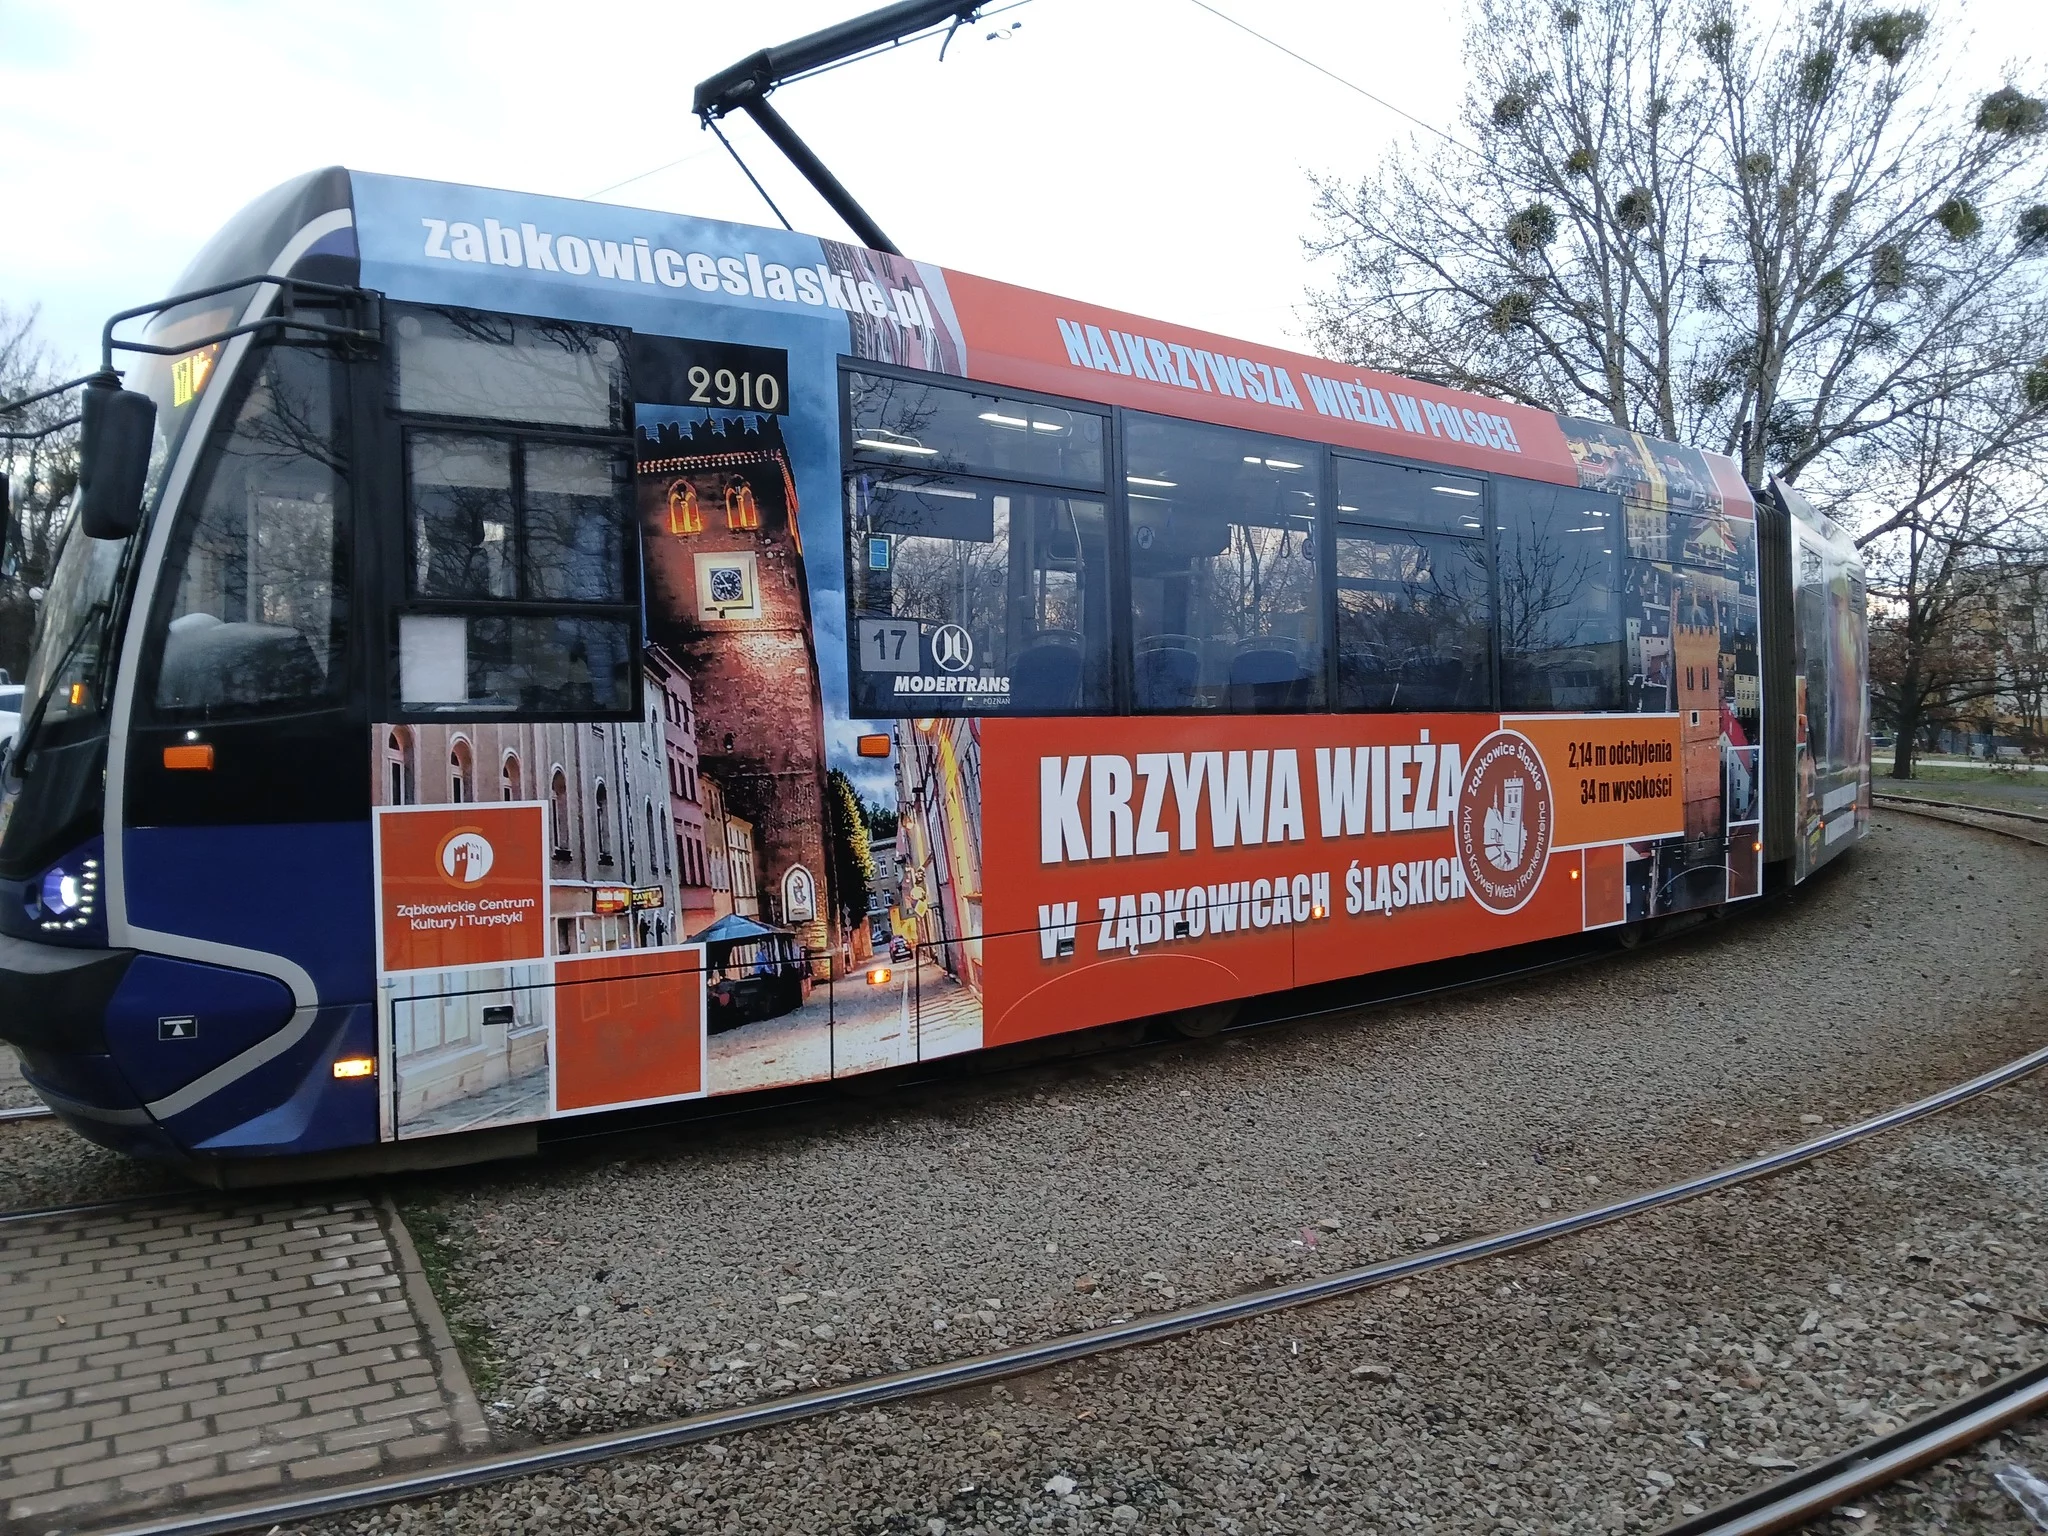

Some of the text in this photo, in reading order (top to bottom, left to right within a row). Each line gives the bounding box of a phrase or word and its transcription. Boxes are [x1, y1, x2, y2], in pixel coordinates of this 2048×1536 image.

[421, 217, 935, 329] zabkowiceslaskie.pl
[687, 365, 780, 410] 2910
[1056, 317, 1522, 454] NAJKRZYWSZA WIEŻA W POLSCE!
[873, 628, 908, 661] 17
[893, 675, 1011, 693] MODERTRANS
[1517, 742, 1543, 792] Śląskie
[1568, 739, 1673, 770] 2,14 m odchylenia
[1040, 728, 1467, 864] KRZYWA WIEŻA
[1580, 773, 1673, 805] 34 m wysokości
[396, 899, 535, 917] Ząbkowickie Centrum
[410, 916, 457, 930] Kultury
[465, 911, 523, 927] Turystyki
[1038, 856, 1468, 960] W ZĄBKOWICACH ŚLĄSKICH
